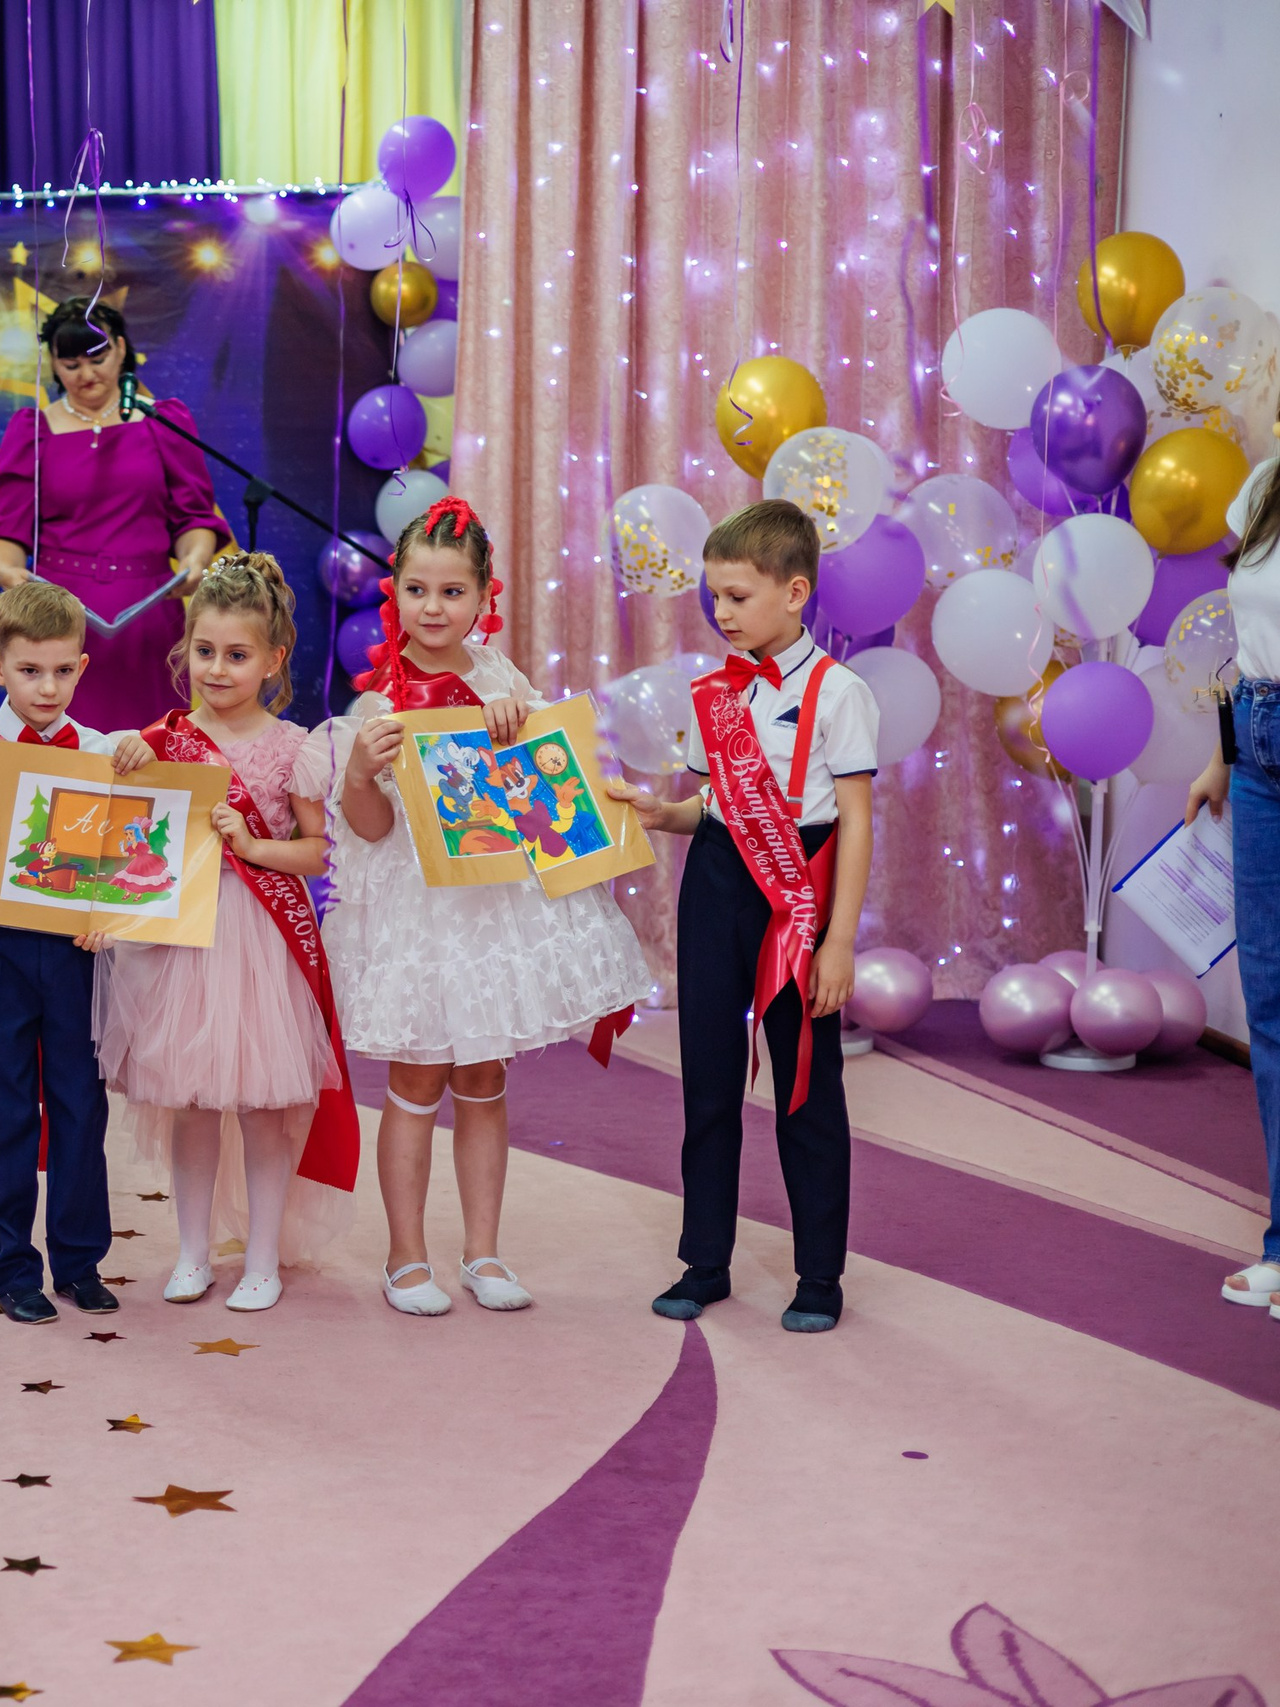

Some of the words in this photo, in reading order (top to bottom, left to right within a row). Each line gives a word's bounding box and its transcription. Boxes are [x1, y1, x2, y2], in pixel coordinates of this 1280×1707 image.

[708, 751, 733, 803] детского
[728, 805, 749, 836] сада
[727, 728, 801, 883] Выпускник
[780, 885, 818, 950] 2024
[284, 904, 319, 967] 2024
